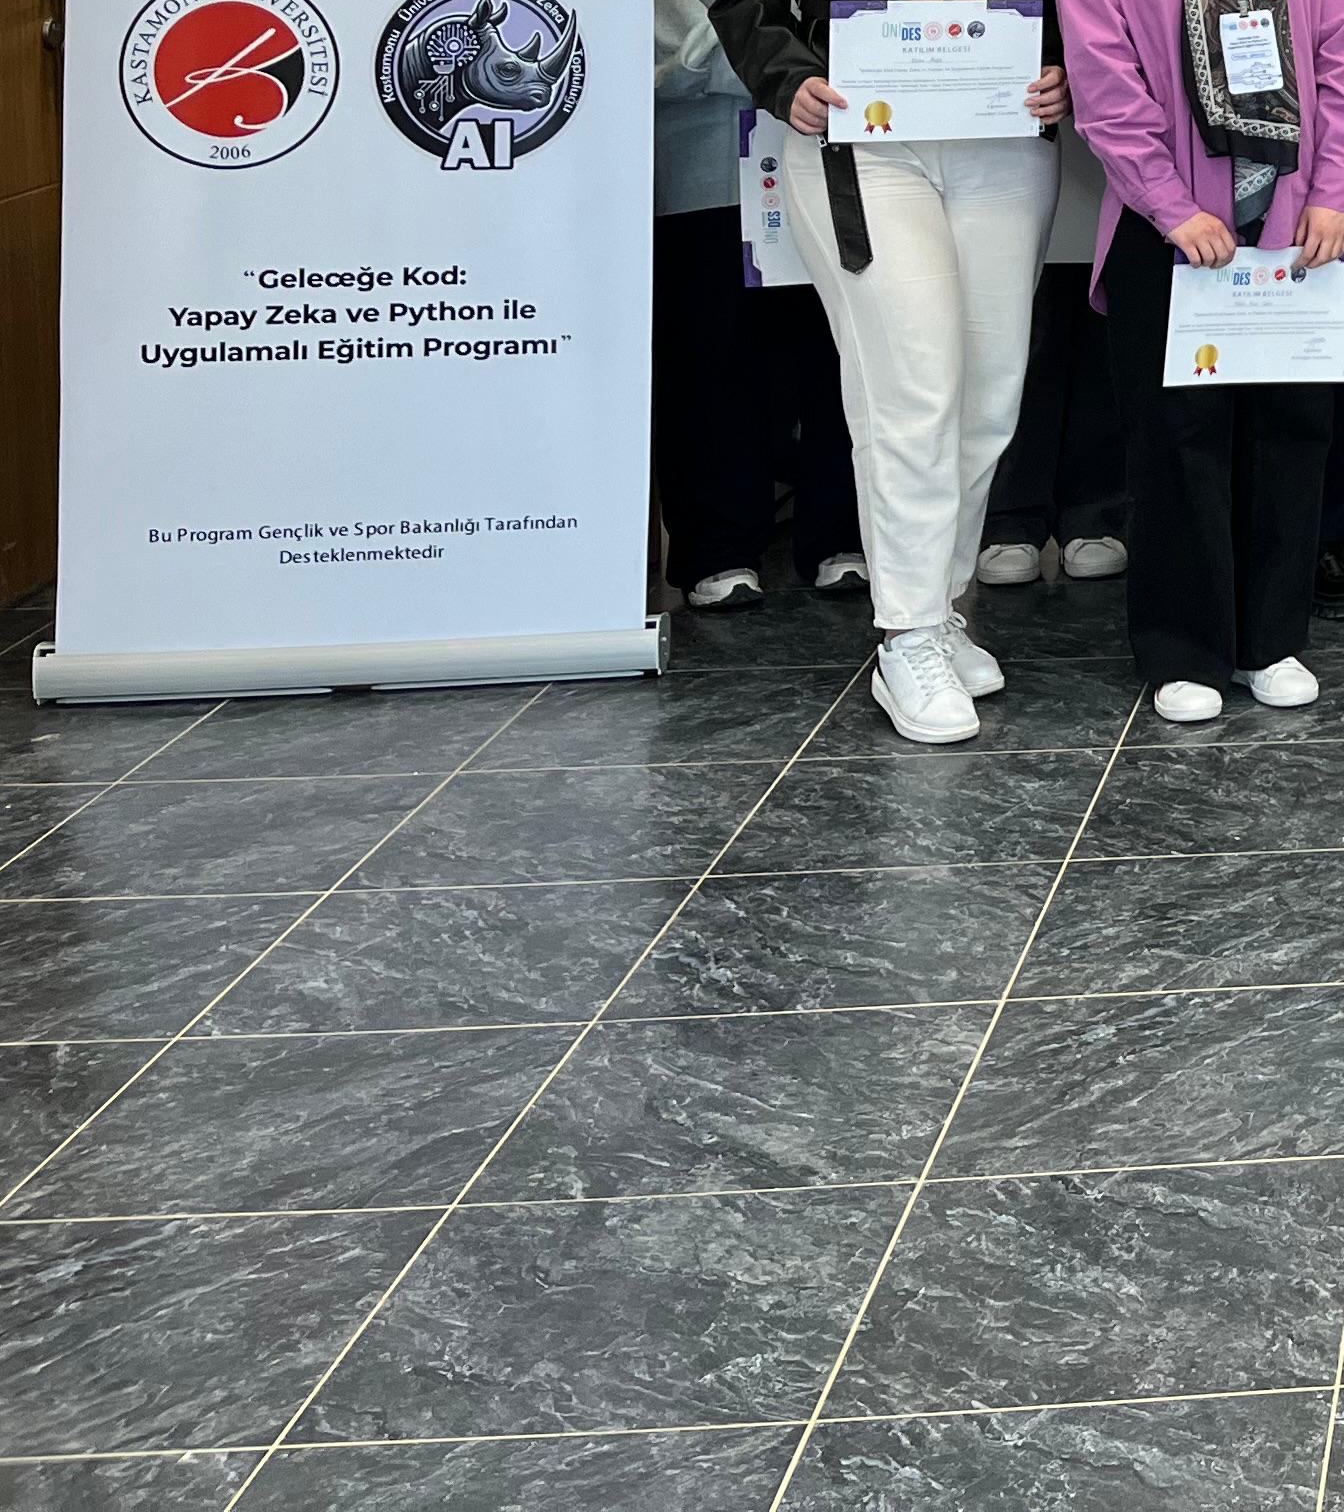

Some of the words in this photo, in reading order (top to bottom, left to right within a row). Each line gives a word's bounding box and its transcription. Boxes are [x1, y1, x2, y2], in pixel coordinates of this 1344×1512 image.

[379, 28, 401, 103] Kastamonu
[209, 144, 252, 160] 2006
[441, 118, 514, 170] AI
[402, 264, 467, 287] Kod:
[168, 306, 258, 332] Yapay
[265, 303, 337, 325] Zeka
[345, 307, 380, 324] ve
[389, 300, 494, 327] Python
[503, 298, 537, 320] ile
[141, 339, 308, 369] Uygulamalı
[318, 336, 414, 365] Eğitim
[148, 528, 172, 544] Bu
[177, 527, 253, 545] Program
[258, 522, 324, 542] Gençlik
[328, 525, 349, 537] ve
[353, 521, 396, 540] Spor
[399, 517, 480, 536] Bakanlığı
[483, 514, 578, 532] Tarafından
[279, 543, 445, 565] Desteklenmektedir
